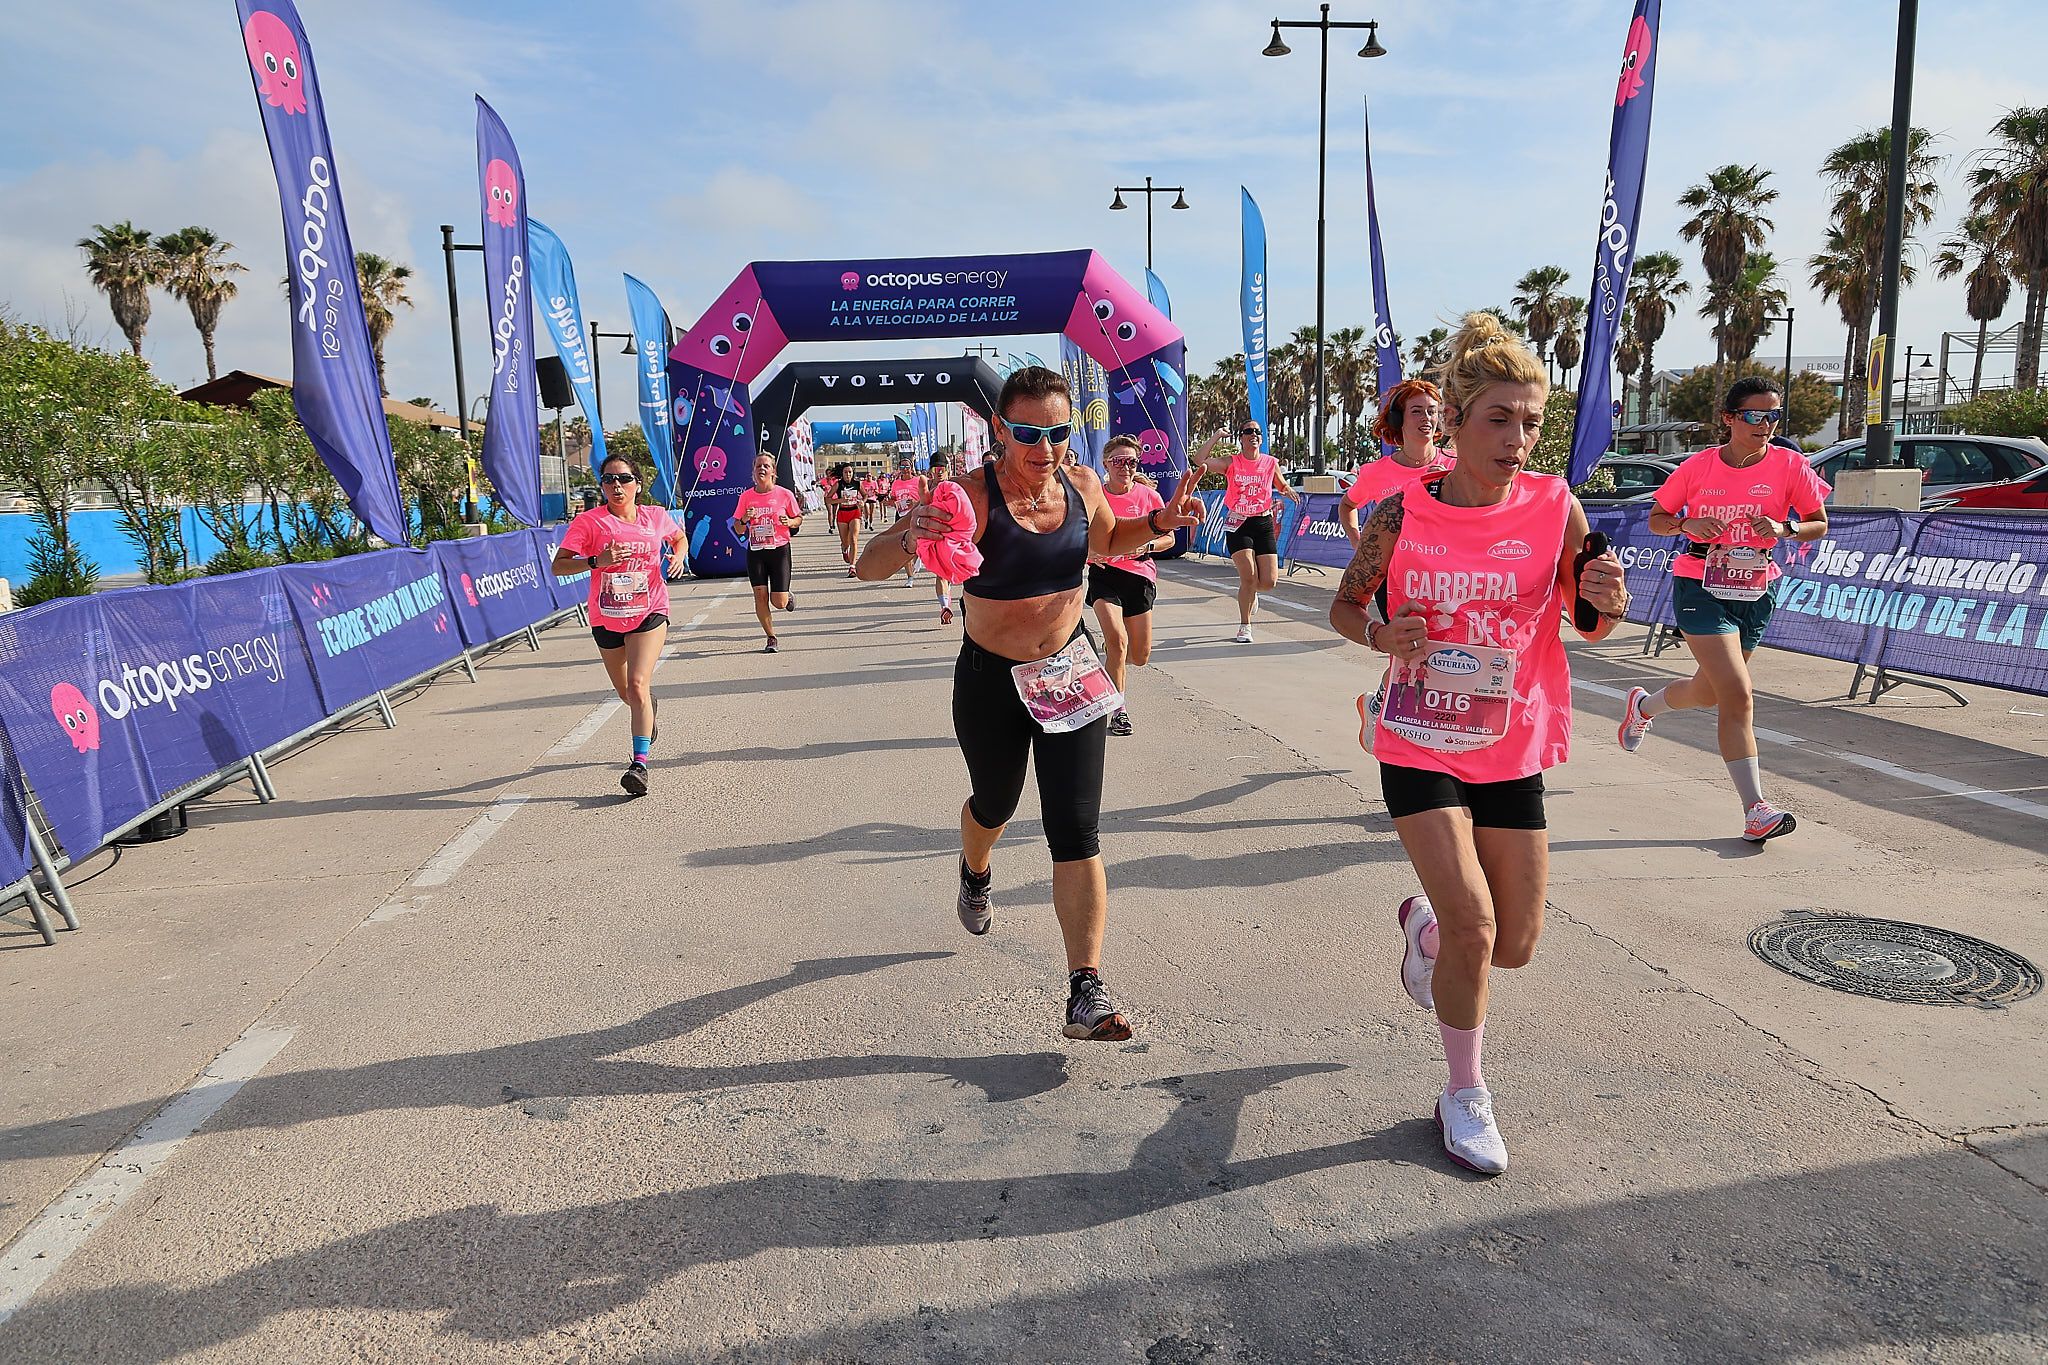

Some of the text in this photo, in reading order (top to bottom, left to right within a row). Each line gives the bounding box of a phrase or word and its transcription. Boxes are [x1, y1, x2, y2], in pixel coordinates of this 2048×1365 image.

[866, 270, 1008, 290] octopus energy
[831, 295, 1016, 312] LA ENERGÍA PARA CORRER
[830, 310, 1019, 326] A LA VELOCIDAD DE LA LUZ
[1807, 362, 1840, 371] EL BOBO
[819, 372, 951, 388] VOLVO
[1698, 504, 1762, 521] CARRERA
[1399, 539, 1447, 556] OYSHO
[1727, 568, 1753, 579] 016
[1811, 539, 1865, 578] Has
[1865, 546, 2037, 594] alcanzado
[1404, 569, 1518, 602] CARRERA
[613, 593, 633, 602] 016
[1776, 575, 1926, 631] VELOCIDAD
[1924, 596, 1978, 639] DE
[1975, 601, 2030, 647] LA
[207, 633, 285, 683] energy
[1430, 655, 1476, 671] ASTURIANA
[1425, 690, 1471, 712] 016
[1394, 714, 1493, 735] CARRERA DE LA MUJER VALENCIA
[1434, 711, 1457, 722] 2220
[1393, 727, 1488, 746] OYSHO Santander
